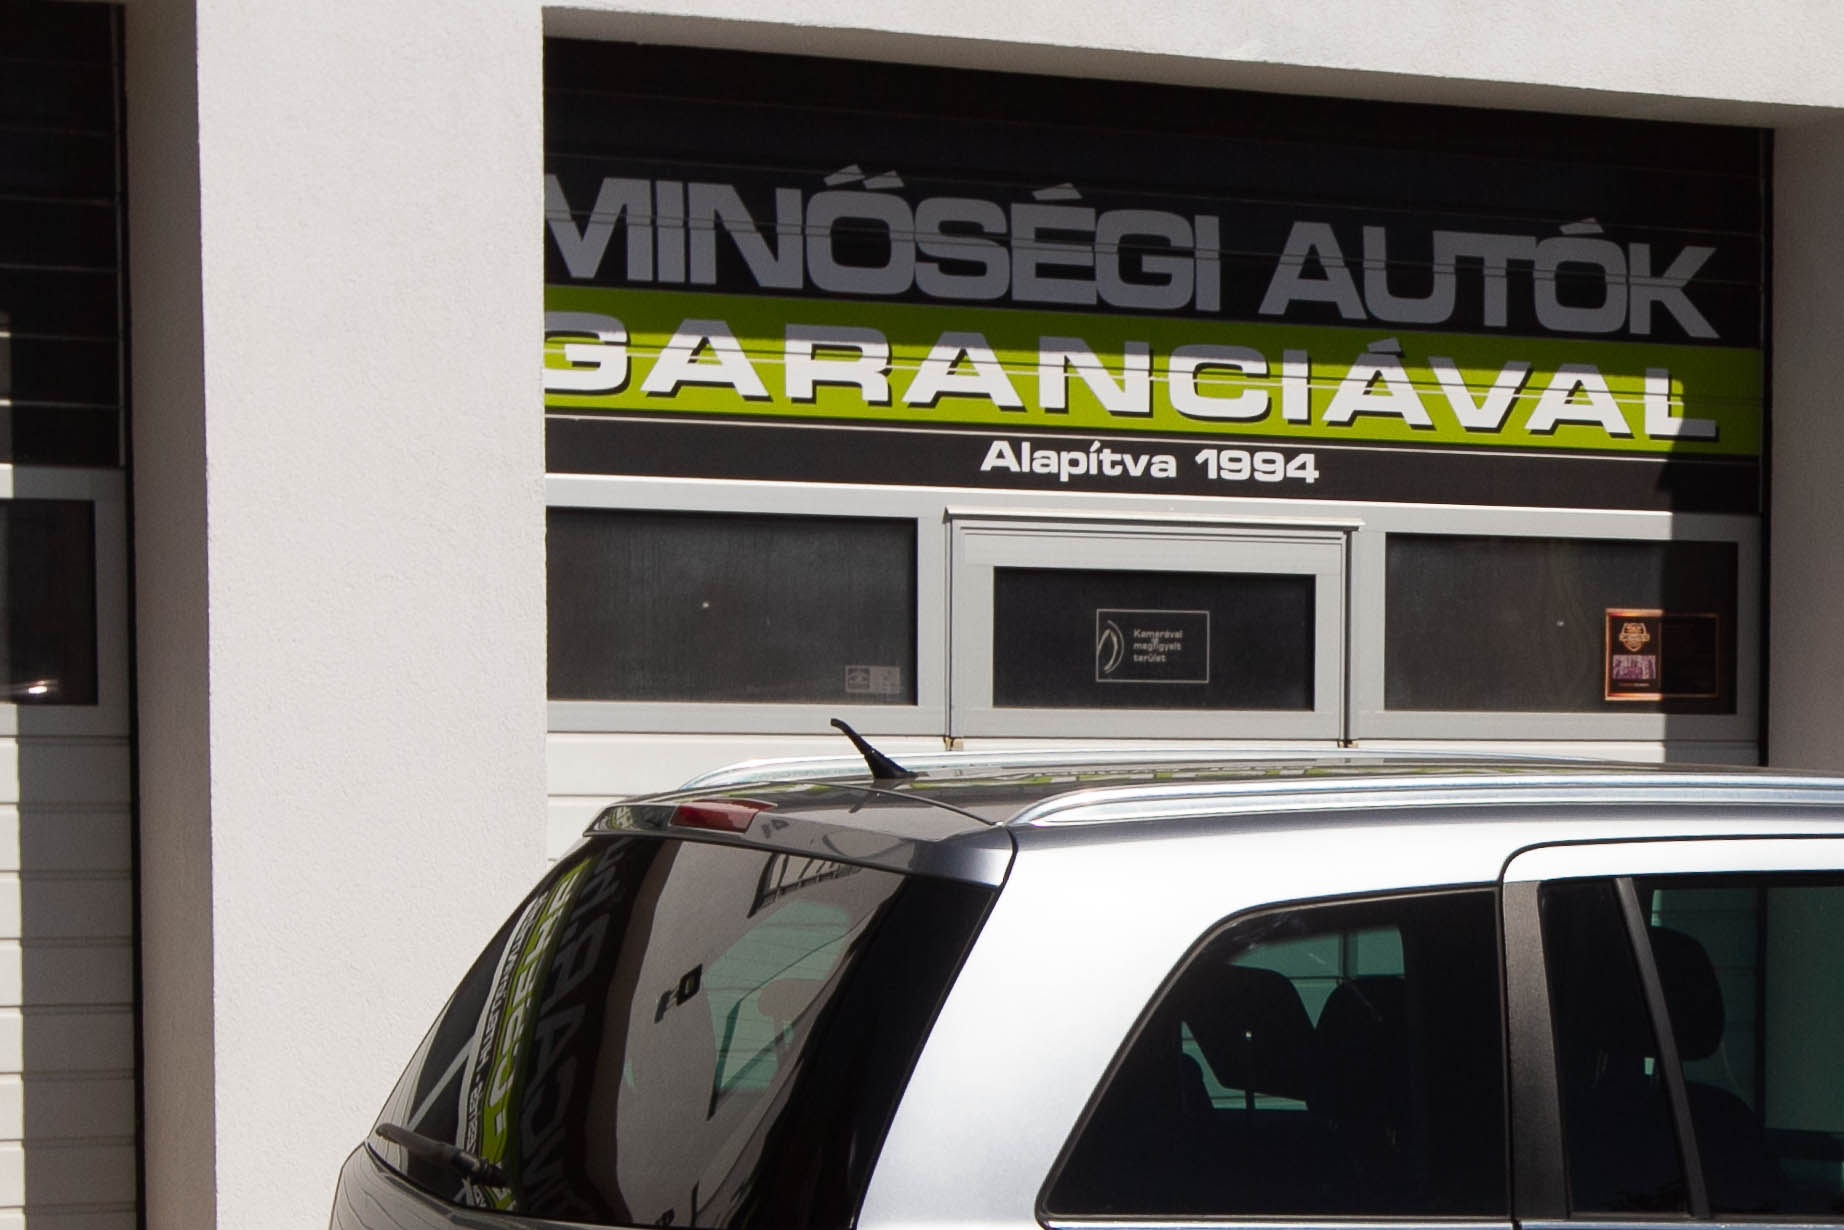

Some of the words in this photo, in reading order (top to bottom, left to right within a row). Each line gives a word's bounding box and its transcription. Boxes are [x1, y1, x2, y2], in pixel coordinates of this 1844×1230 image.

[545, 164, 1220, 312] MINŐSÉGI
[1258, 217, 1720, 339] AUTÓK
[545, 311, 1718, 443] GARANCIÁVAL
[980, 439, 1177, 482] Alapítva
[1195, 449, 1320, 484] 1994
